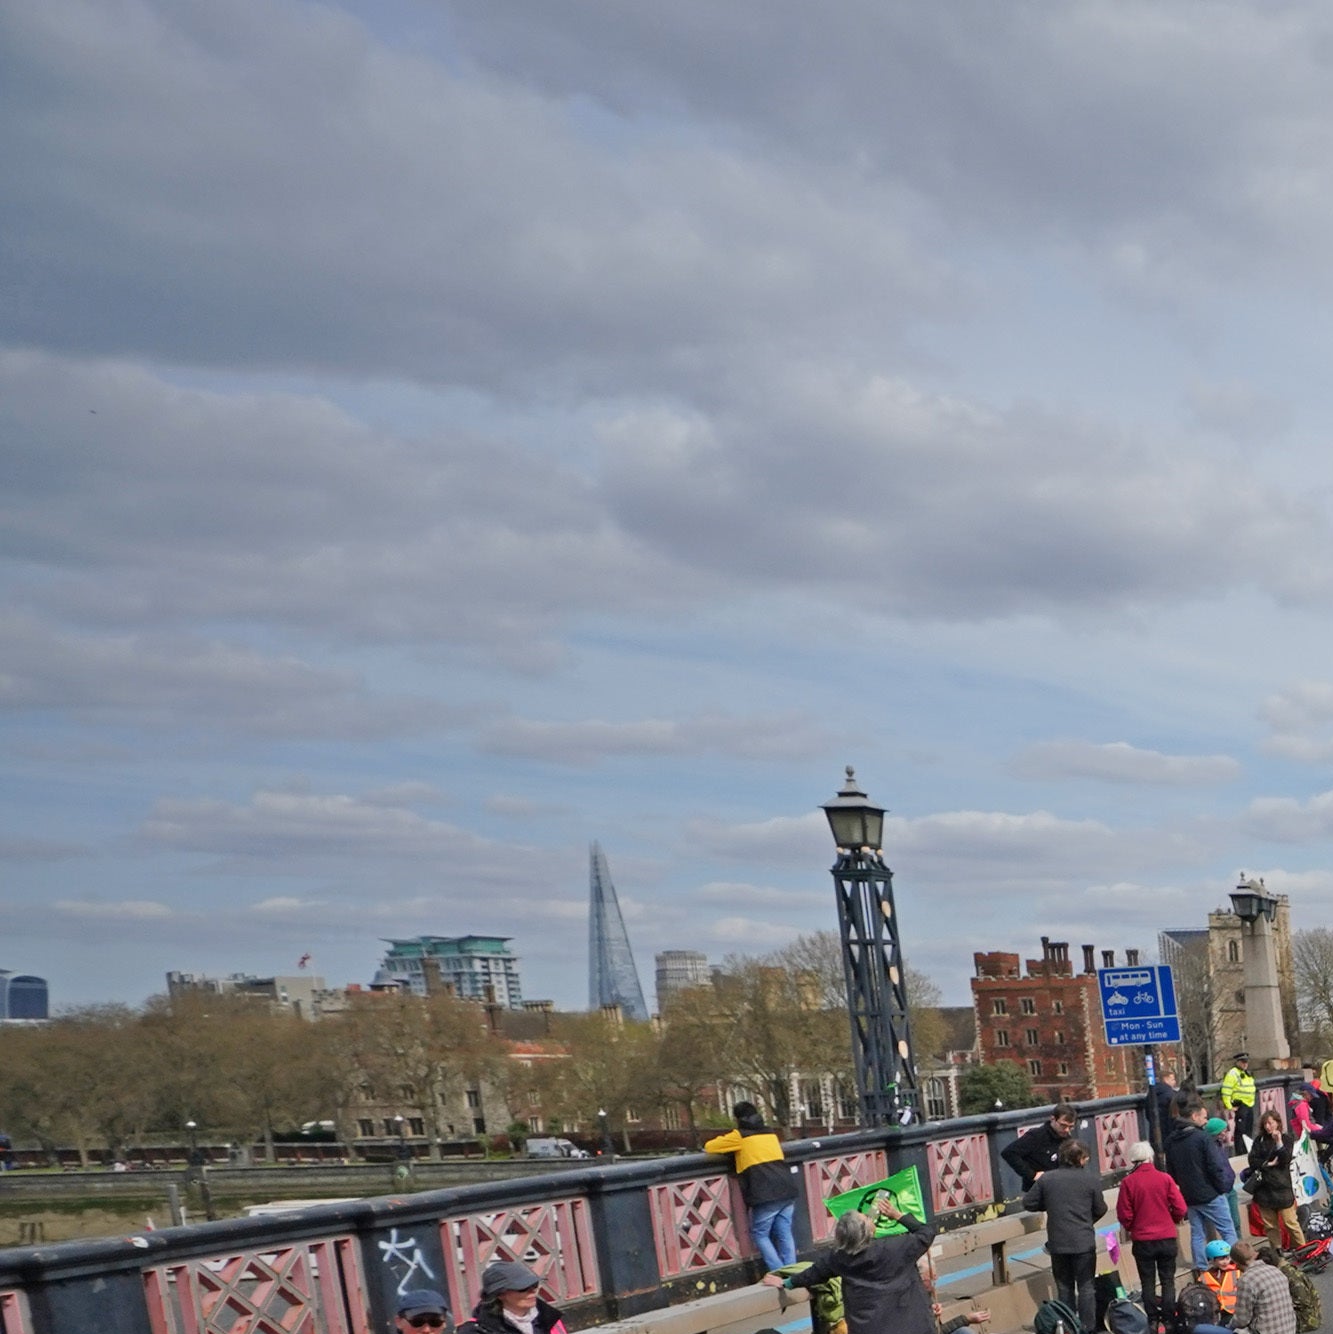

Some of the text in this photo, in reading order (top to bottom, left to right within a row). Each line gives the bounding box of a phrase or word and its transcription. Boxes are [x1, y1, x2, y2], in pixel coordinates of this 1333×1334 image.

[1109, 1008, 1126, 1016] taxi
[1121, 1022, 1141, 1031] Mon
[1146, 1020, 1164, 1029] Sun
[1119, 1031, 1168, 1041] at any time
